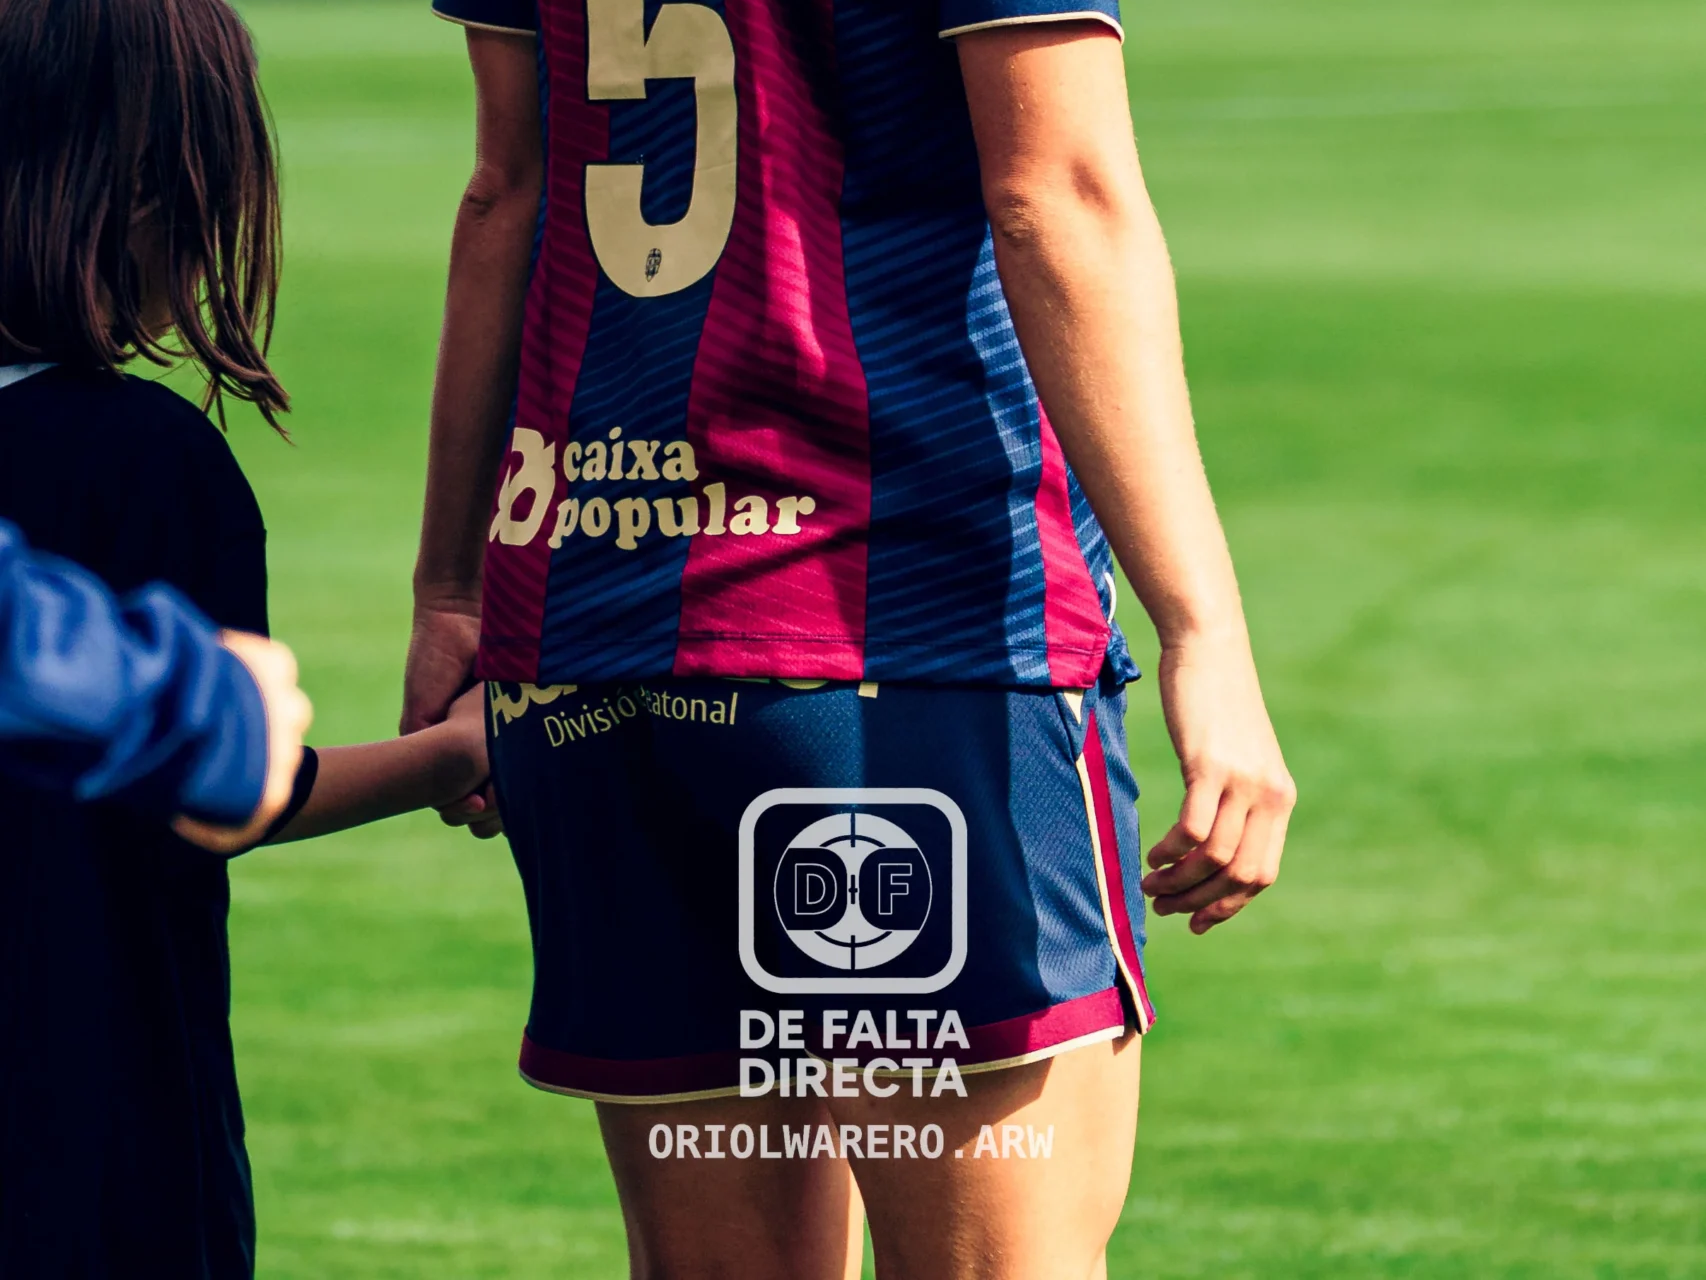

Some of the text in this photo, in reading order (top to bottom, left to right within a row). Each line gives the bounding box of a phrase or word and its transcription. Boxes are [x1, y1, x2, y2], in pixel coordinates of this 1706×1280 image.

[563, 426, 699, 481] caixa
[547, 482, 816, 550] popular
[543, 685, 645, 748] Divisió
